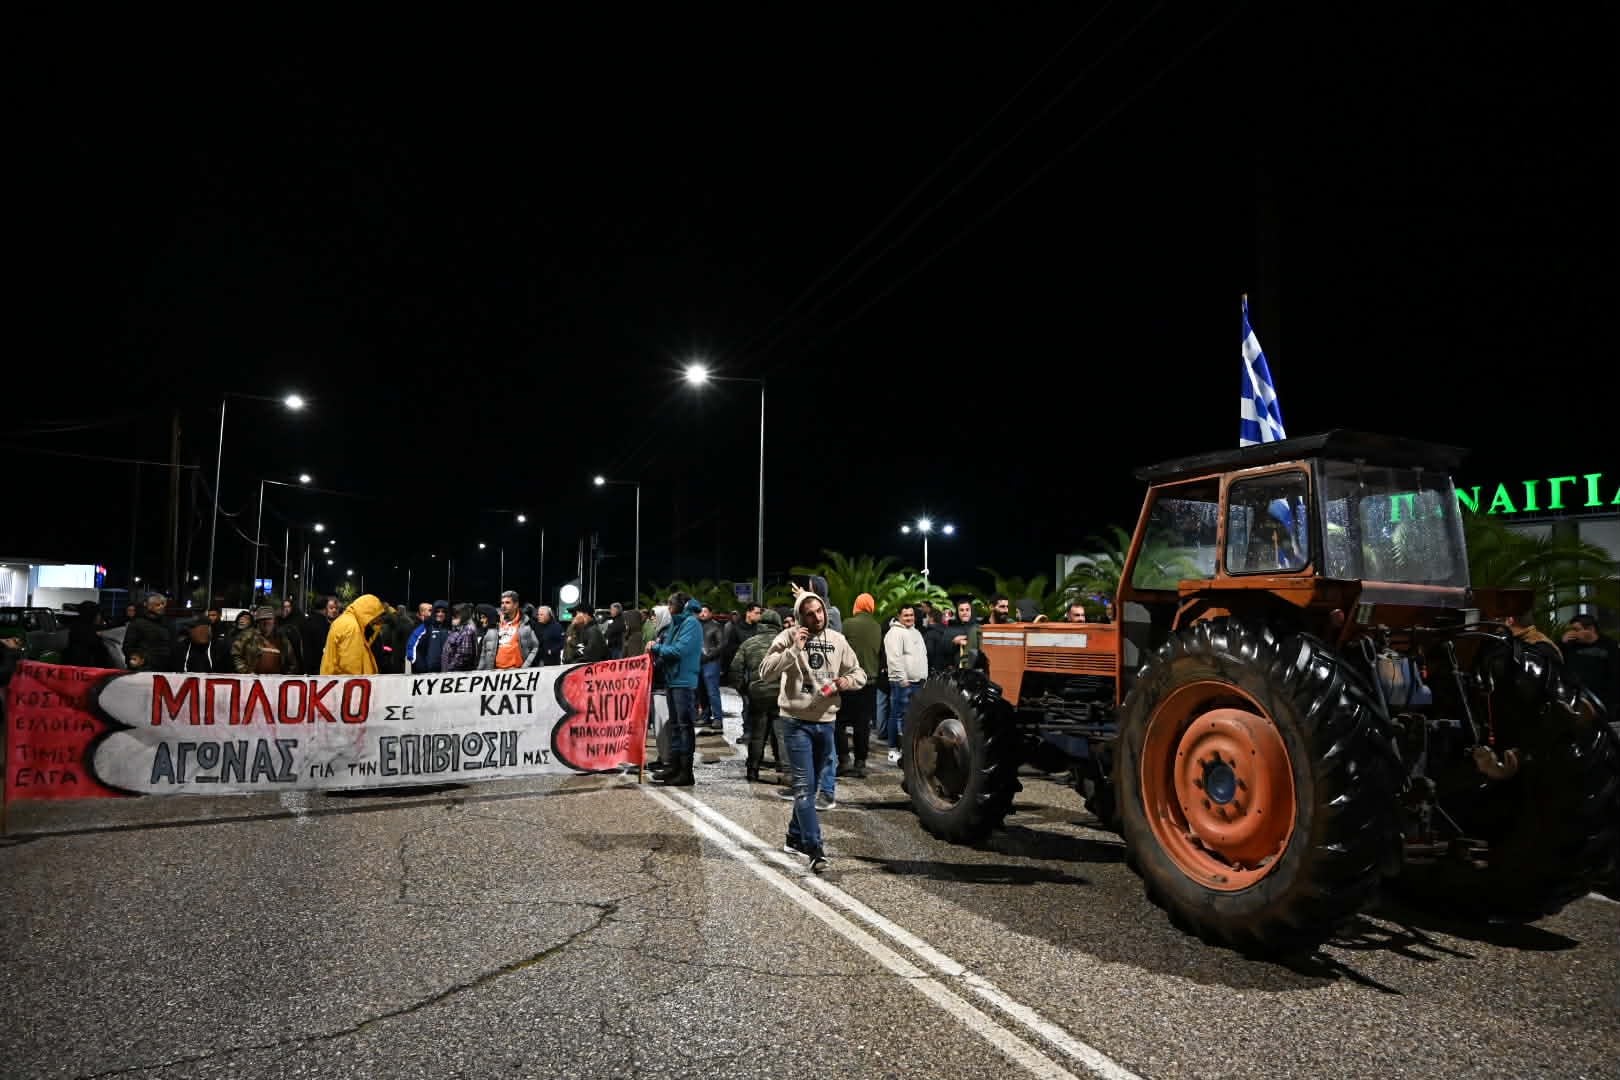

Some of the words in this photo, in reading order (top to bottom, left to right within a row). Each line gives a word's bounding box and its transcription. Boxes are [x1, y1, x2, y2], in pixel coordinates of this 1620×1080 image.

[584, 658, 648, 676] ΑΓΡΟΤΙΚΟΣ
[411, 671, 540, 696] ΚΥΒΕΡΝΗΣΗ
[584, 677, 641, 692] ΣΥΛΛΟΓΟΣ
[150, 674, 372, 726] ΜΠΛΟΚΟ
[383, 705, 415, 721] ΣΕ
[480, 694, 533, 716] ΚΑΠ
[584, 692, 637, 723] ΑΙΓΙΟΥ
[150, 738, 298, 785] ΑΓΩΝΑΣ
[310, 763, 335, 779] ΓΙΑ
[347, 761, 377, 777] ΤΗΝ
[379, 730, 519, 778] ΕΠΙΒΙΩΣΗ
[523, 749, 551, 766] ΜΑΣ
[15, 767, 78, 787] ΕΛΓΑ
